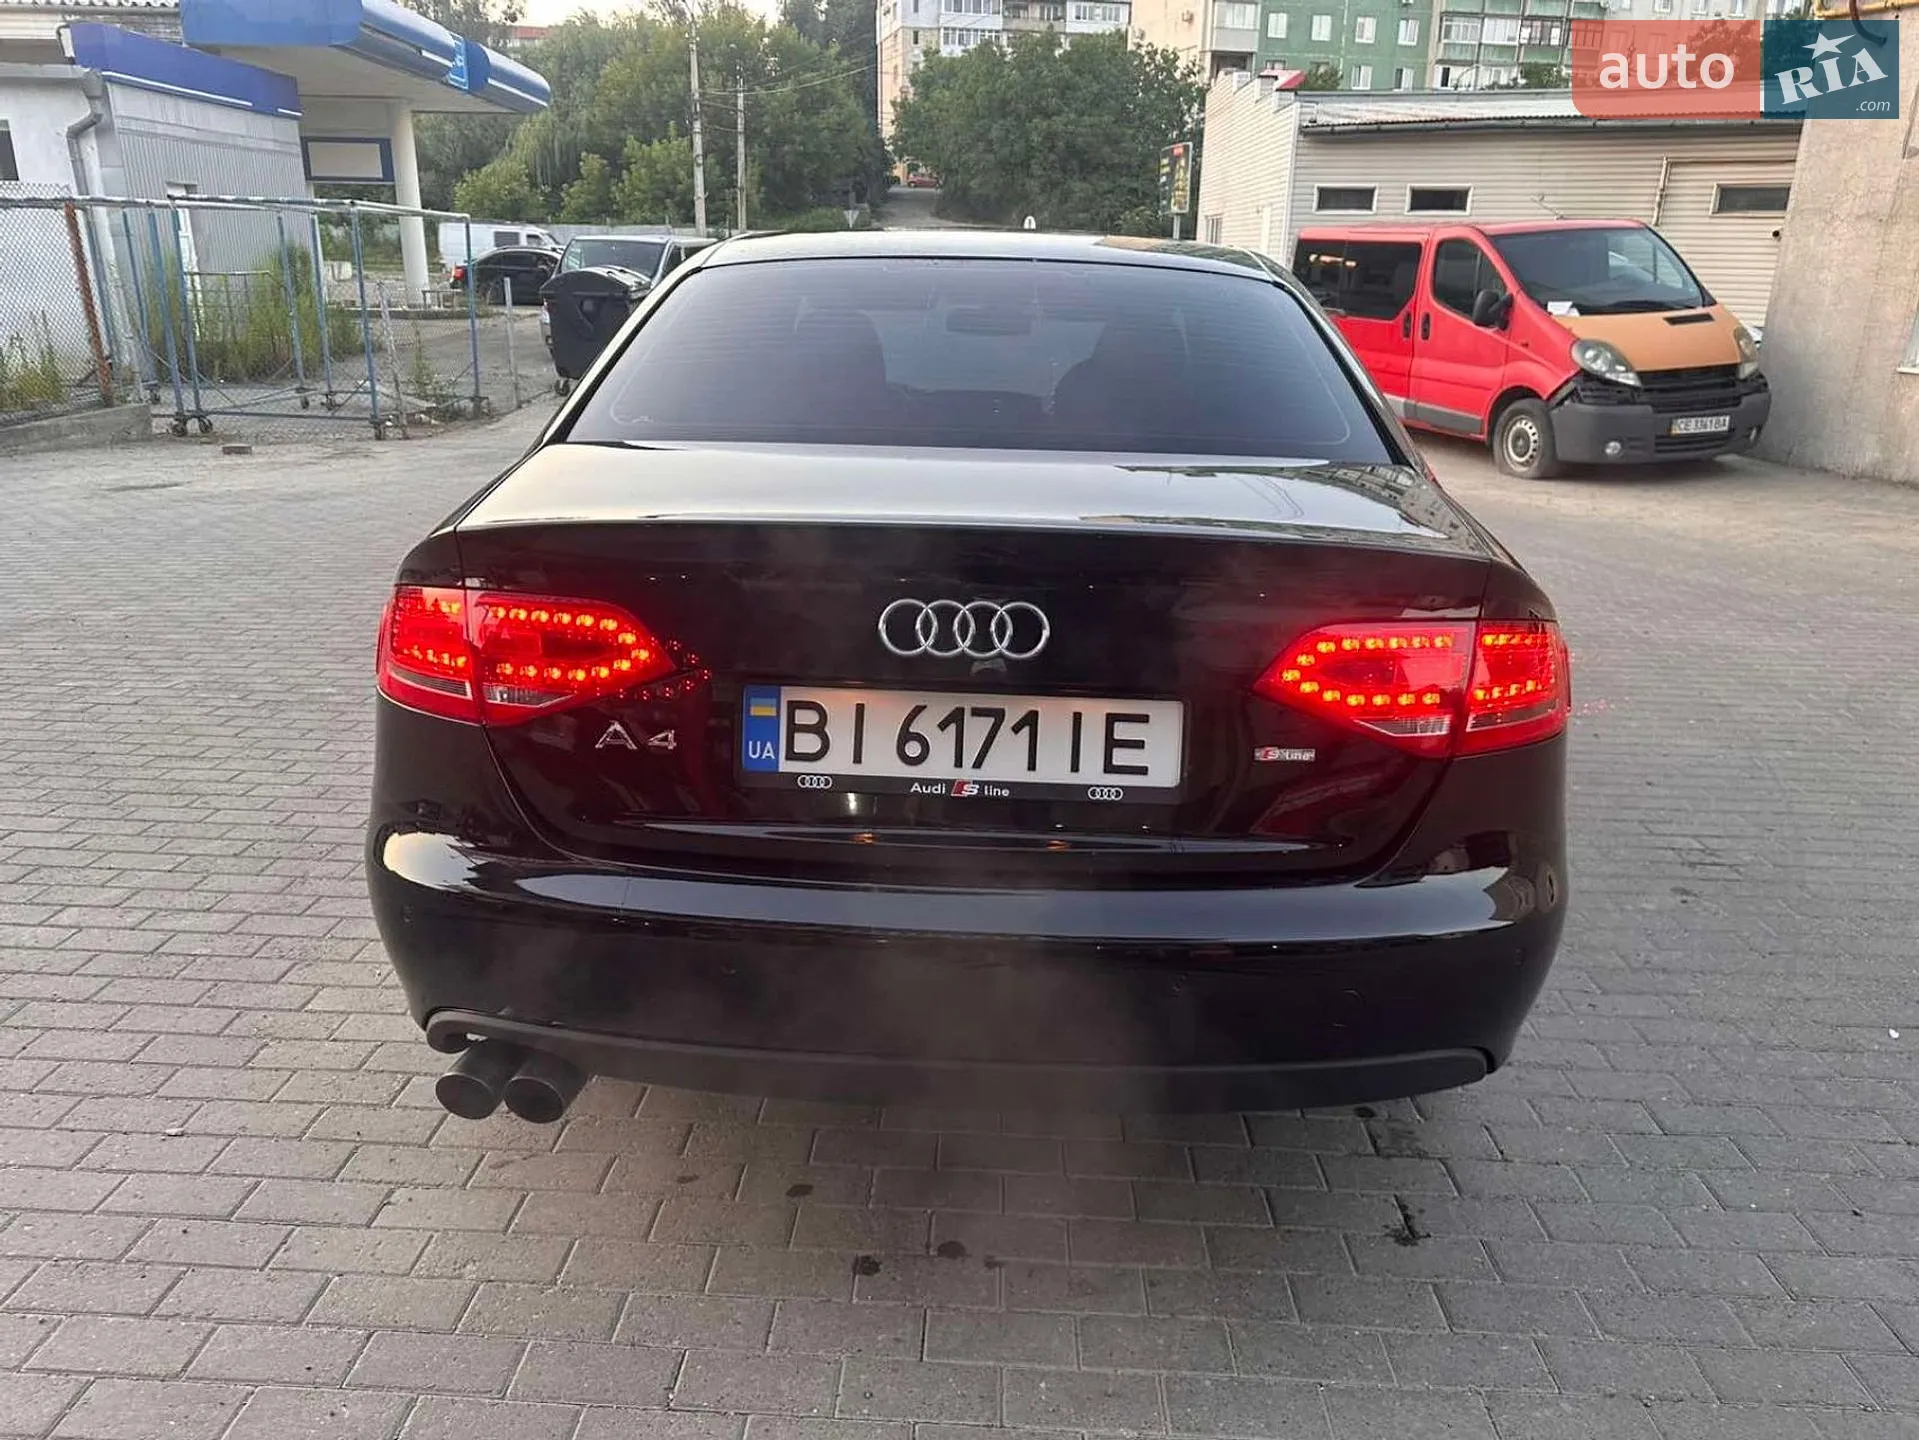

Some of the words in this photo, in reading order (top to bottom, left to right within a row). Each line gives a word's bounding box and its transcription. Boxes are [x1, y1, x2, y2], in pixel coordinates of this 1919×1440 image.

[785, 700, 865, 764] BI
[896, 704, 1039, 771] 6171
[1070, 712, 1150, 775] IE
[748, 741, 775, 759] UA
[910, 782, 946, 795] Audi
[984, 784, 1010, 796] line
